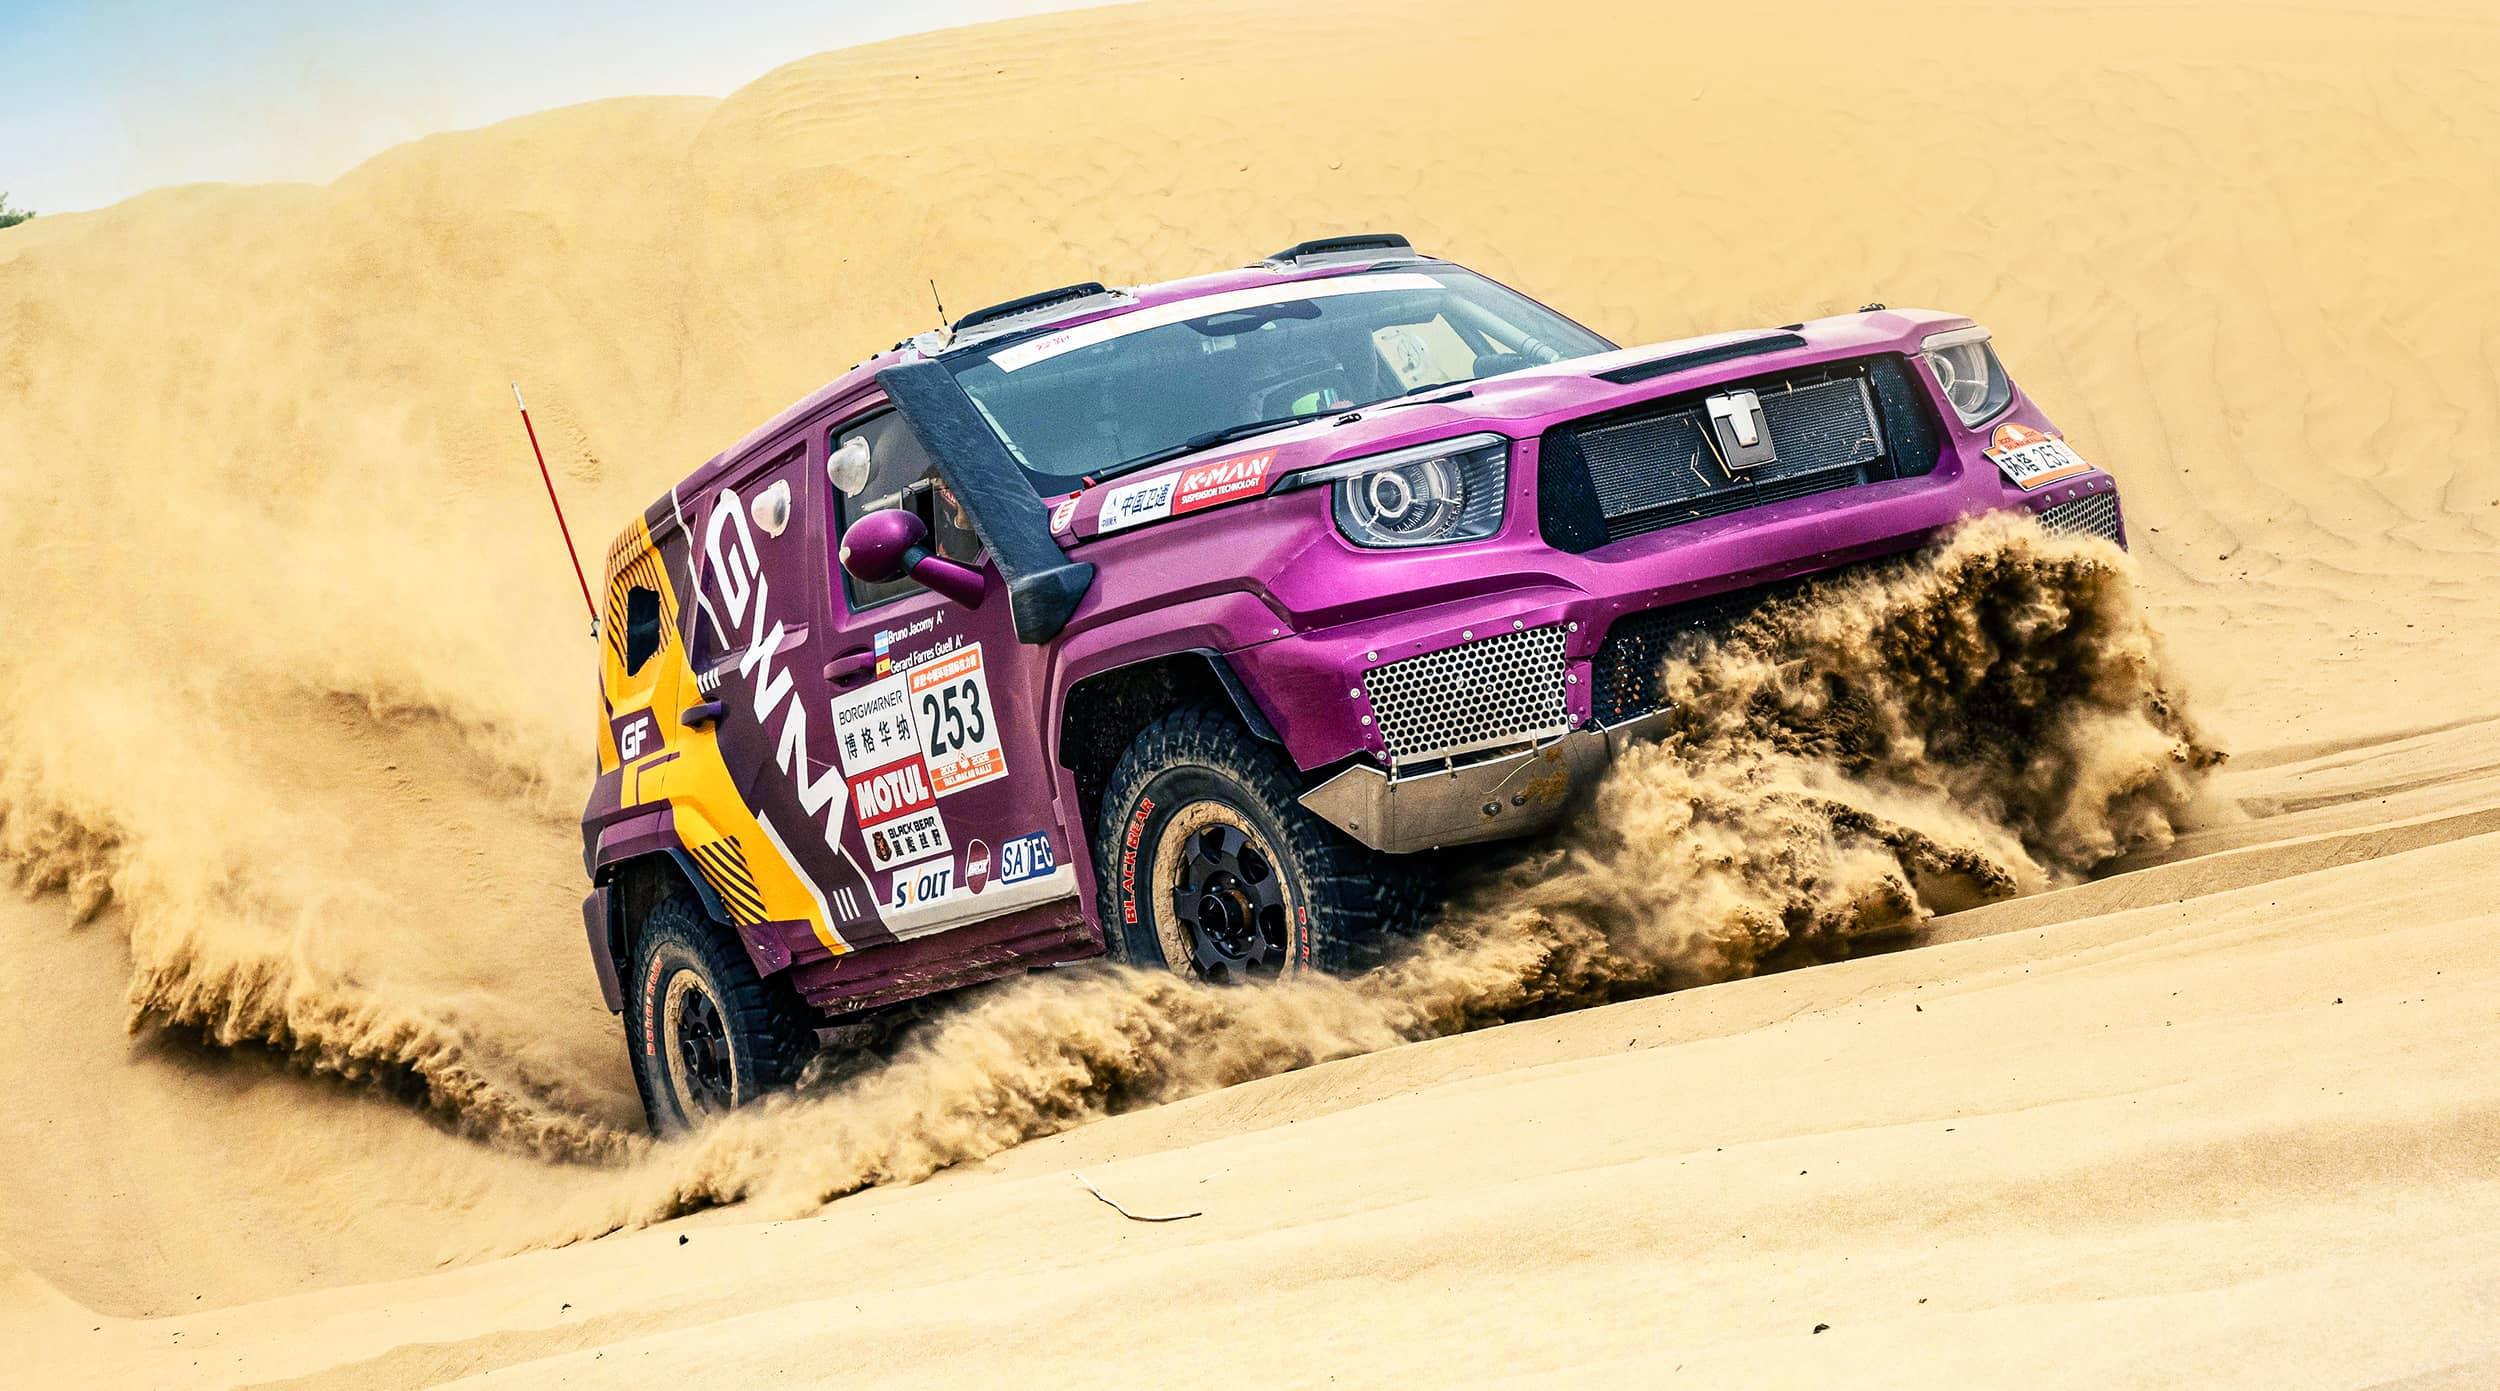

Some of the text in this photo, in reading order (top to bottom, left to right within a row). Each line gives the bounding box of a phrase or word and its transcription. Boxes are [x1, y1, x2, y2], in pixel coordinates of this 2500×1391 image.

[2031, 445, 2070, 469] 253
[1121, 483, 1171, 517] 中国卫通
[1181, 477, 1260, 505] SUSPENSION TECHNOLOGY
[887, 630, 908, 645] Bruno
[909, 616, 934, 637] Jacomy
[706, 488, 849, 855] GWM
[890, 653, 913, 674] Gerard
[913, 648, 935, 665] Farres
[839, 690, 903, 726] BORGWARNER
[922, 678, 985, 758] 253
[621, 716, 649, 761] GF
[844, 714, 911, 761] 博格华纳
[855, 763, 930, 821] MOTUL
[888, 816, 936, 839] BLACK BEAR
[1003, 835, 1055, 877] SATEC
[1121, 796, 1156, 925] BLACK BEAR
[895, 867, 951, 909] SVOLT
